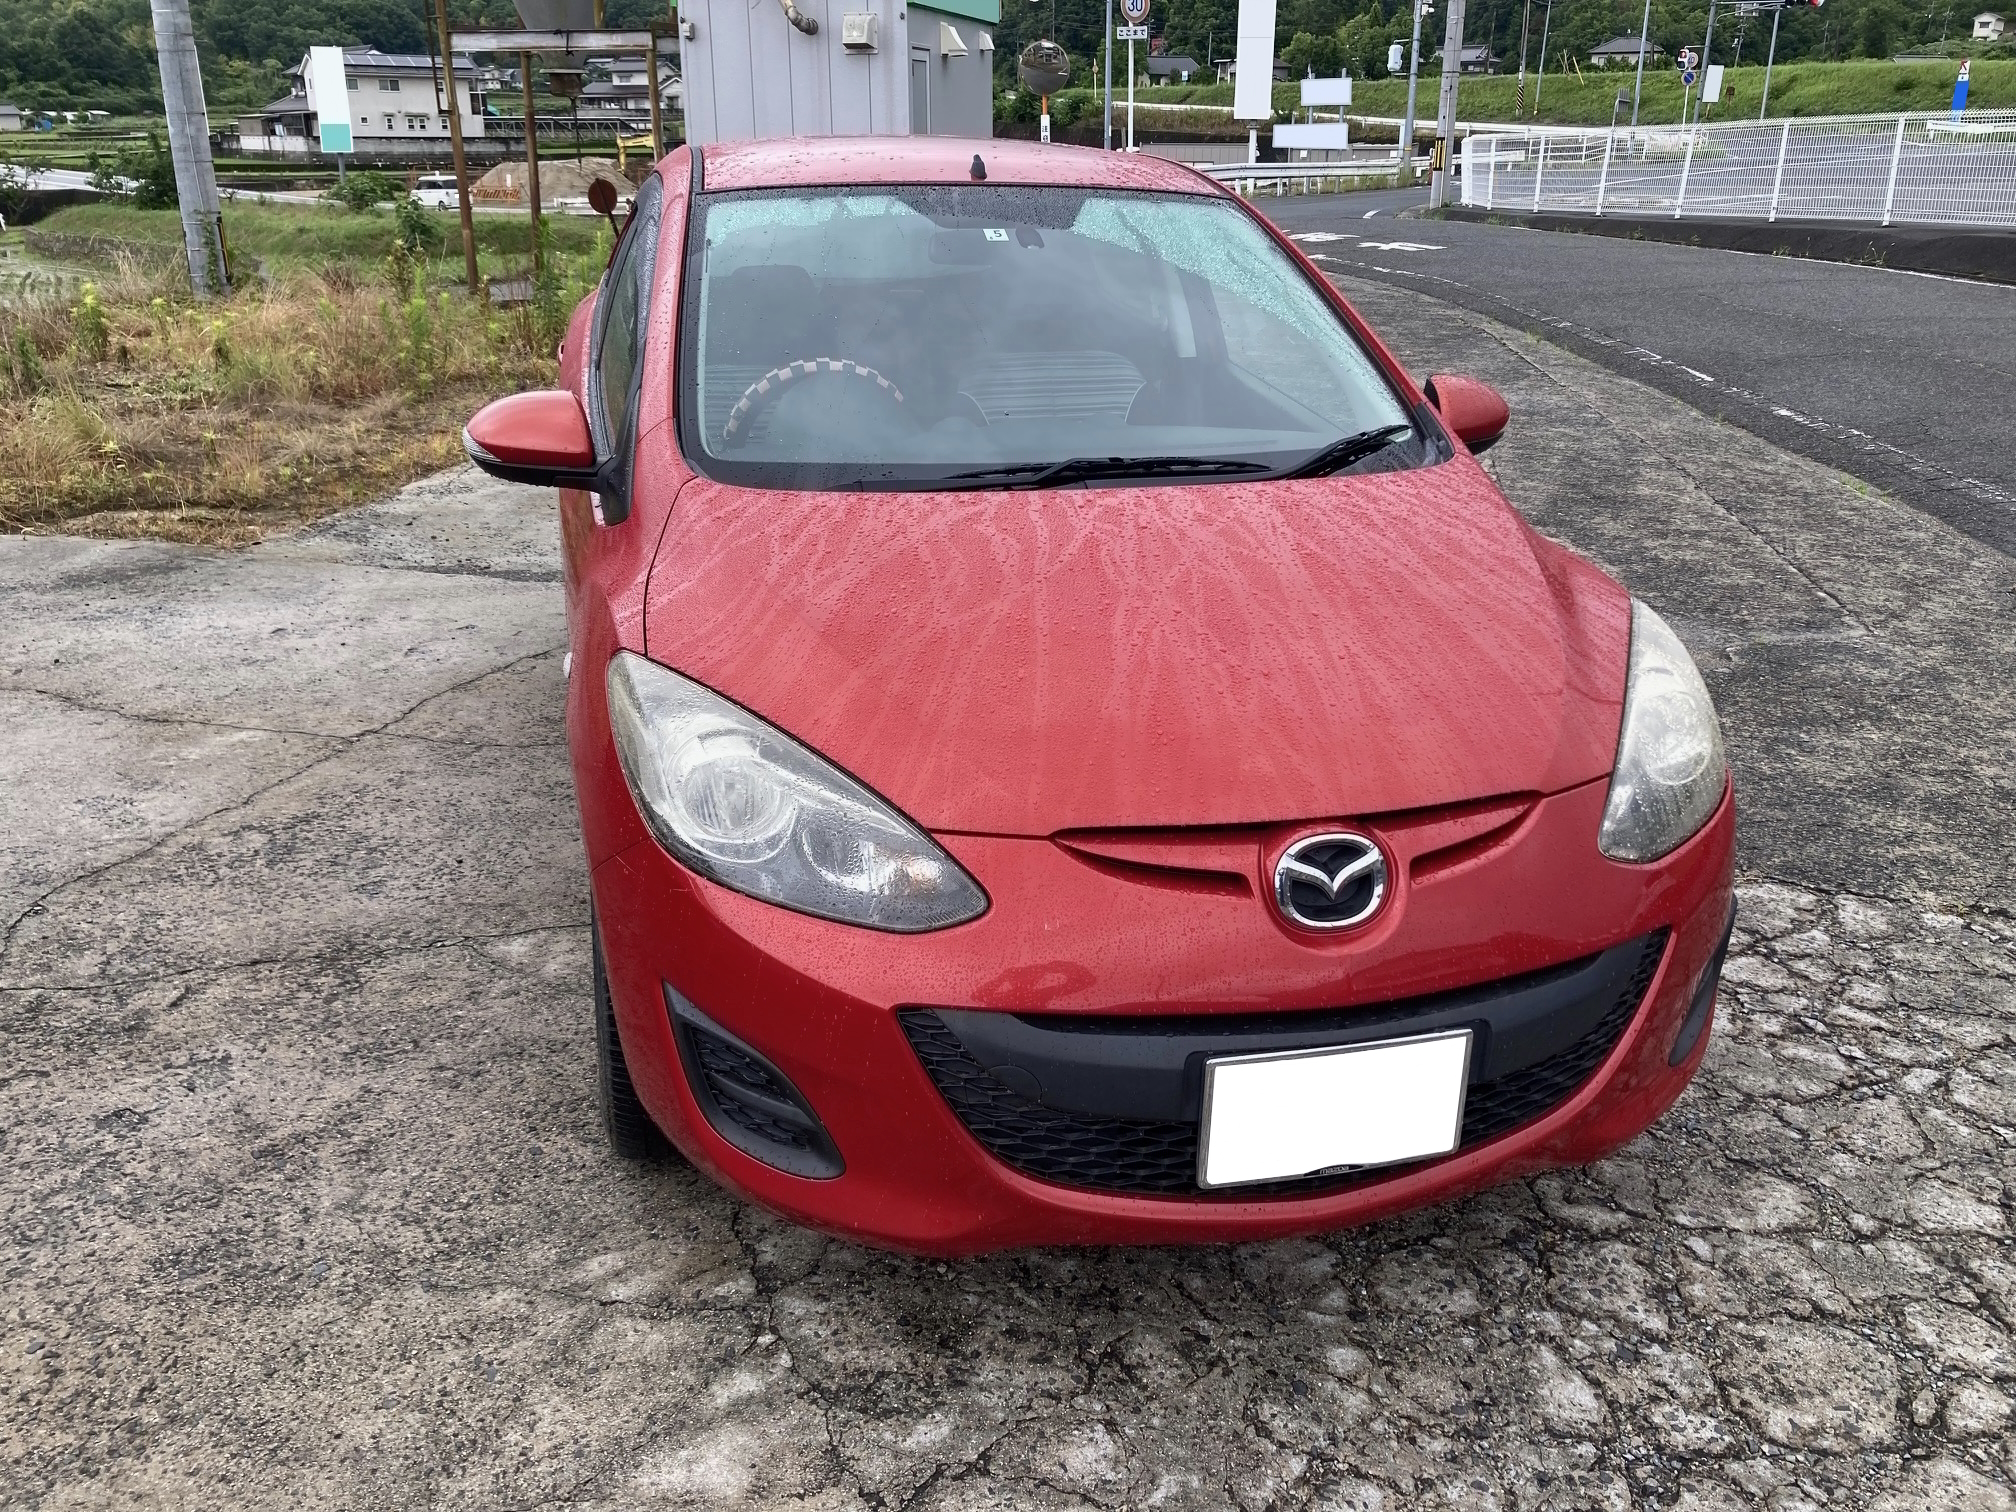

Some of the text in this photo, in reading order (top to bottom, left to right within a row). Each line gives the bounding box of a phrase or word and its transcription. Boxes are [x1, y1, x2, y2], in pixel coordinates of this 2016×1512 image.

[1127, 0, 1143, 12] 30
[1118, 28, 1146, 37] ここまで
[993, 230, 1002, 238] 5
